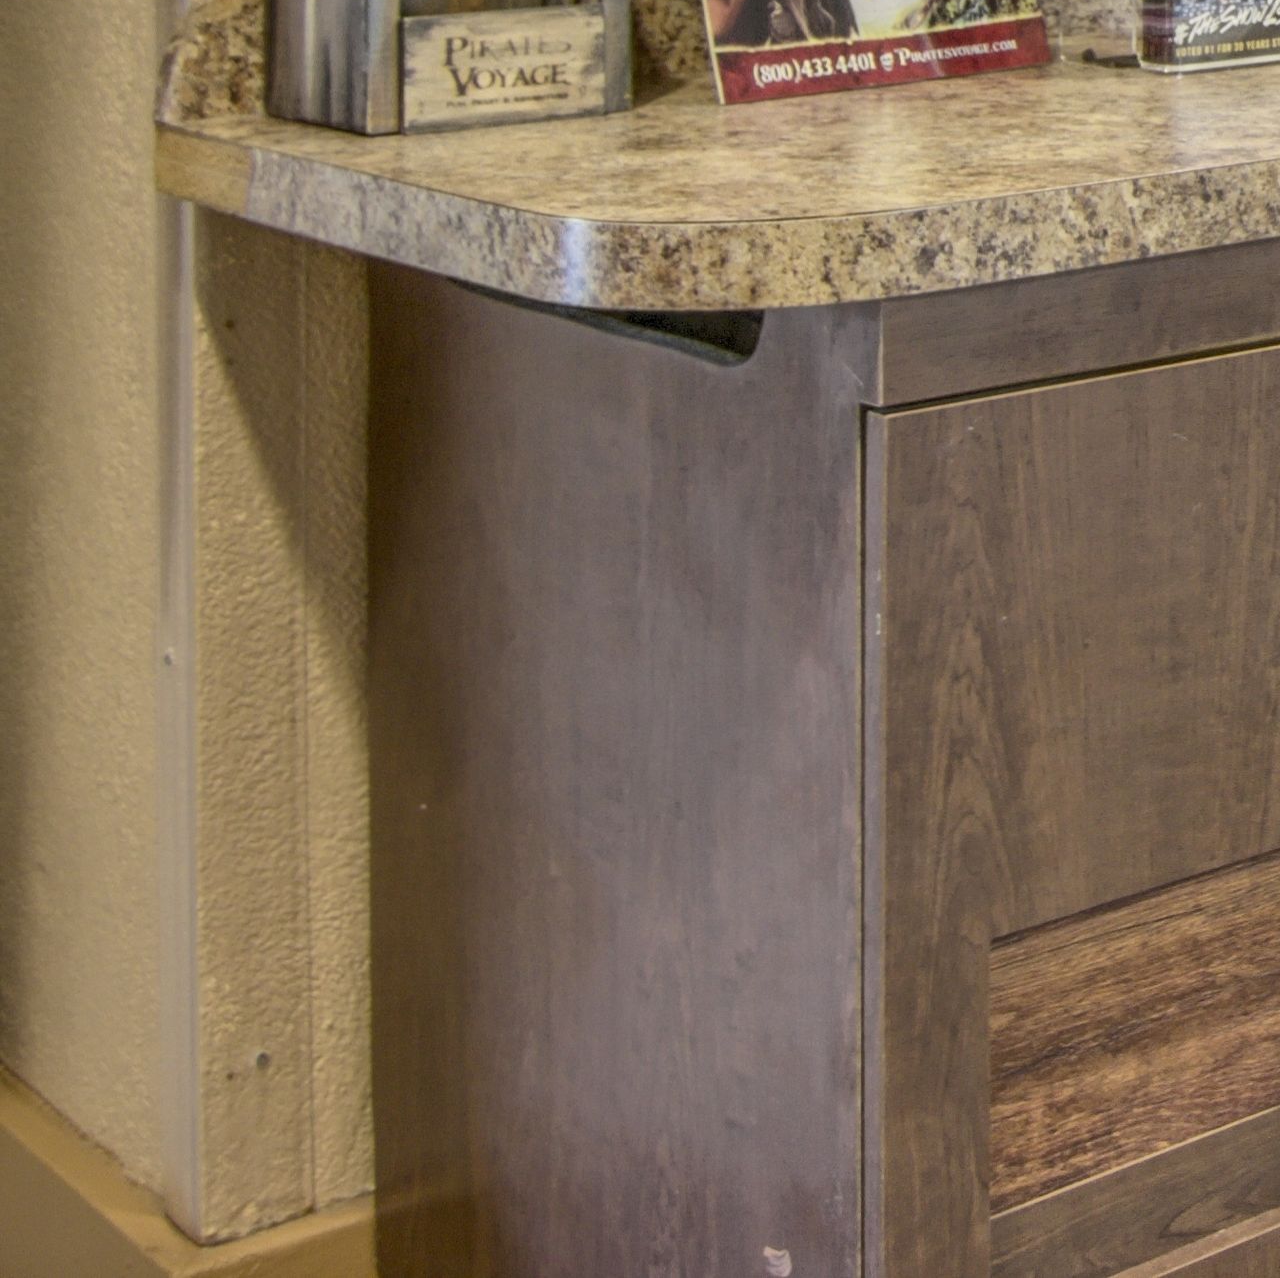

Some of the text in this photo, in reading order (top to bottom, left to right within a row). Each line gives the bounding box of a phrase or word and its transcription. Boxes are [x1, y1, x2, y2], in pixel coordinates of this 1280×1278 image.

[1176, 45, 1201, 58] VOTED
[1246, 38, 1270, 51] YEARS
[448, 62, 573, 97] VOYAGE
